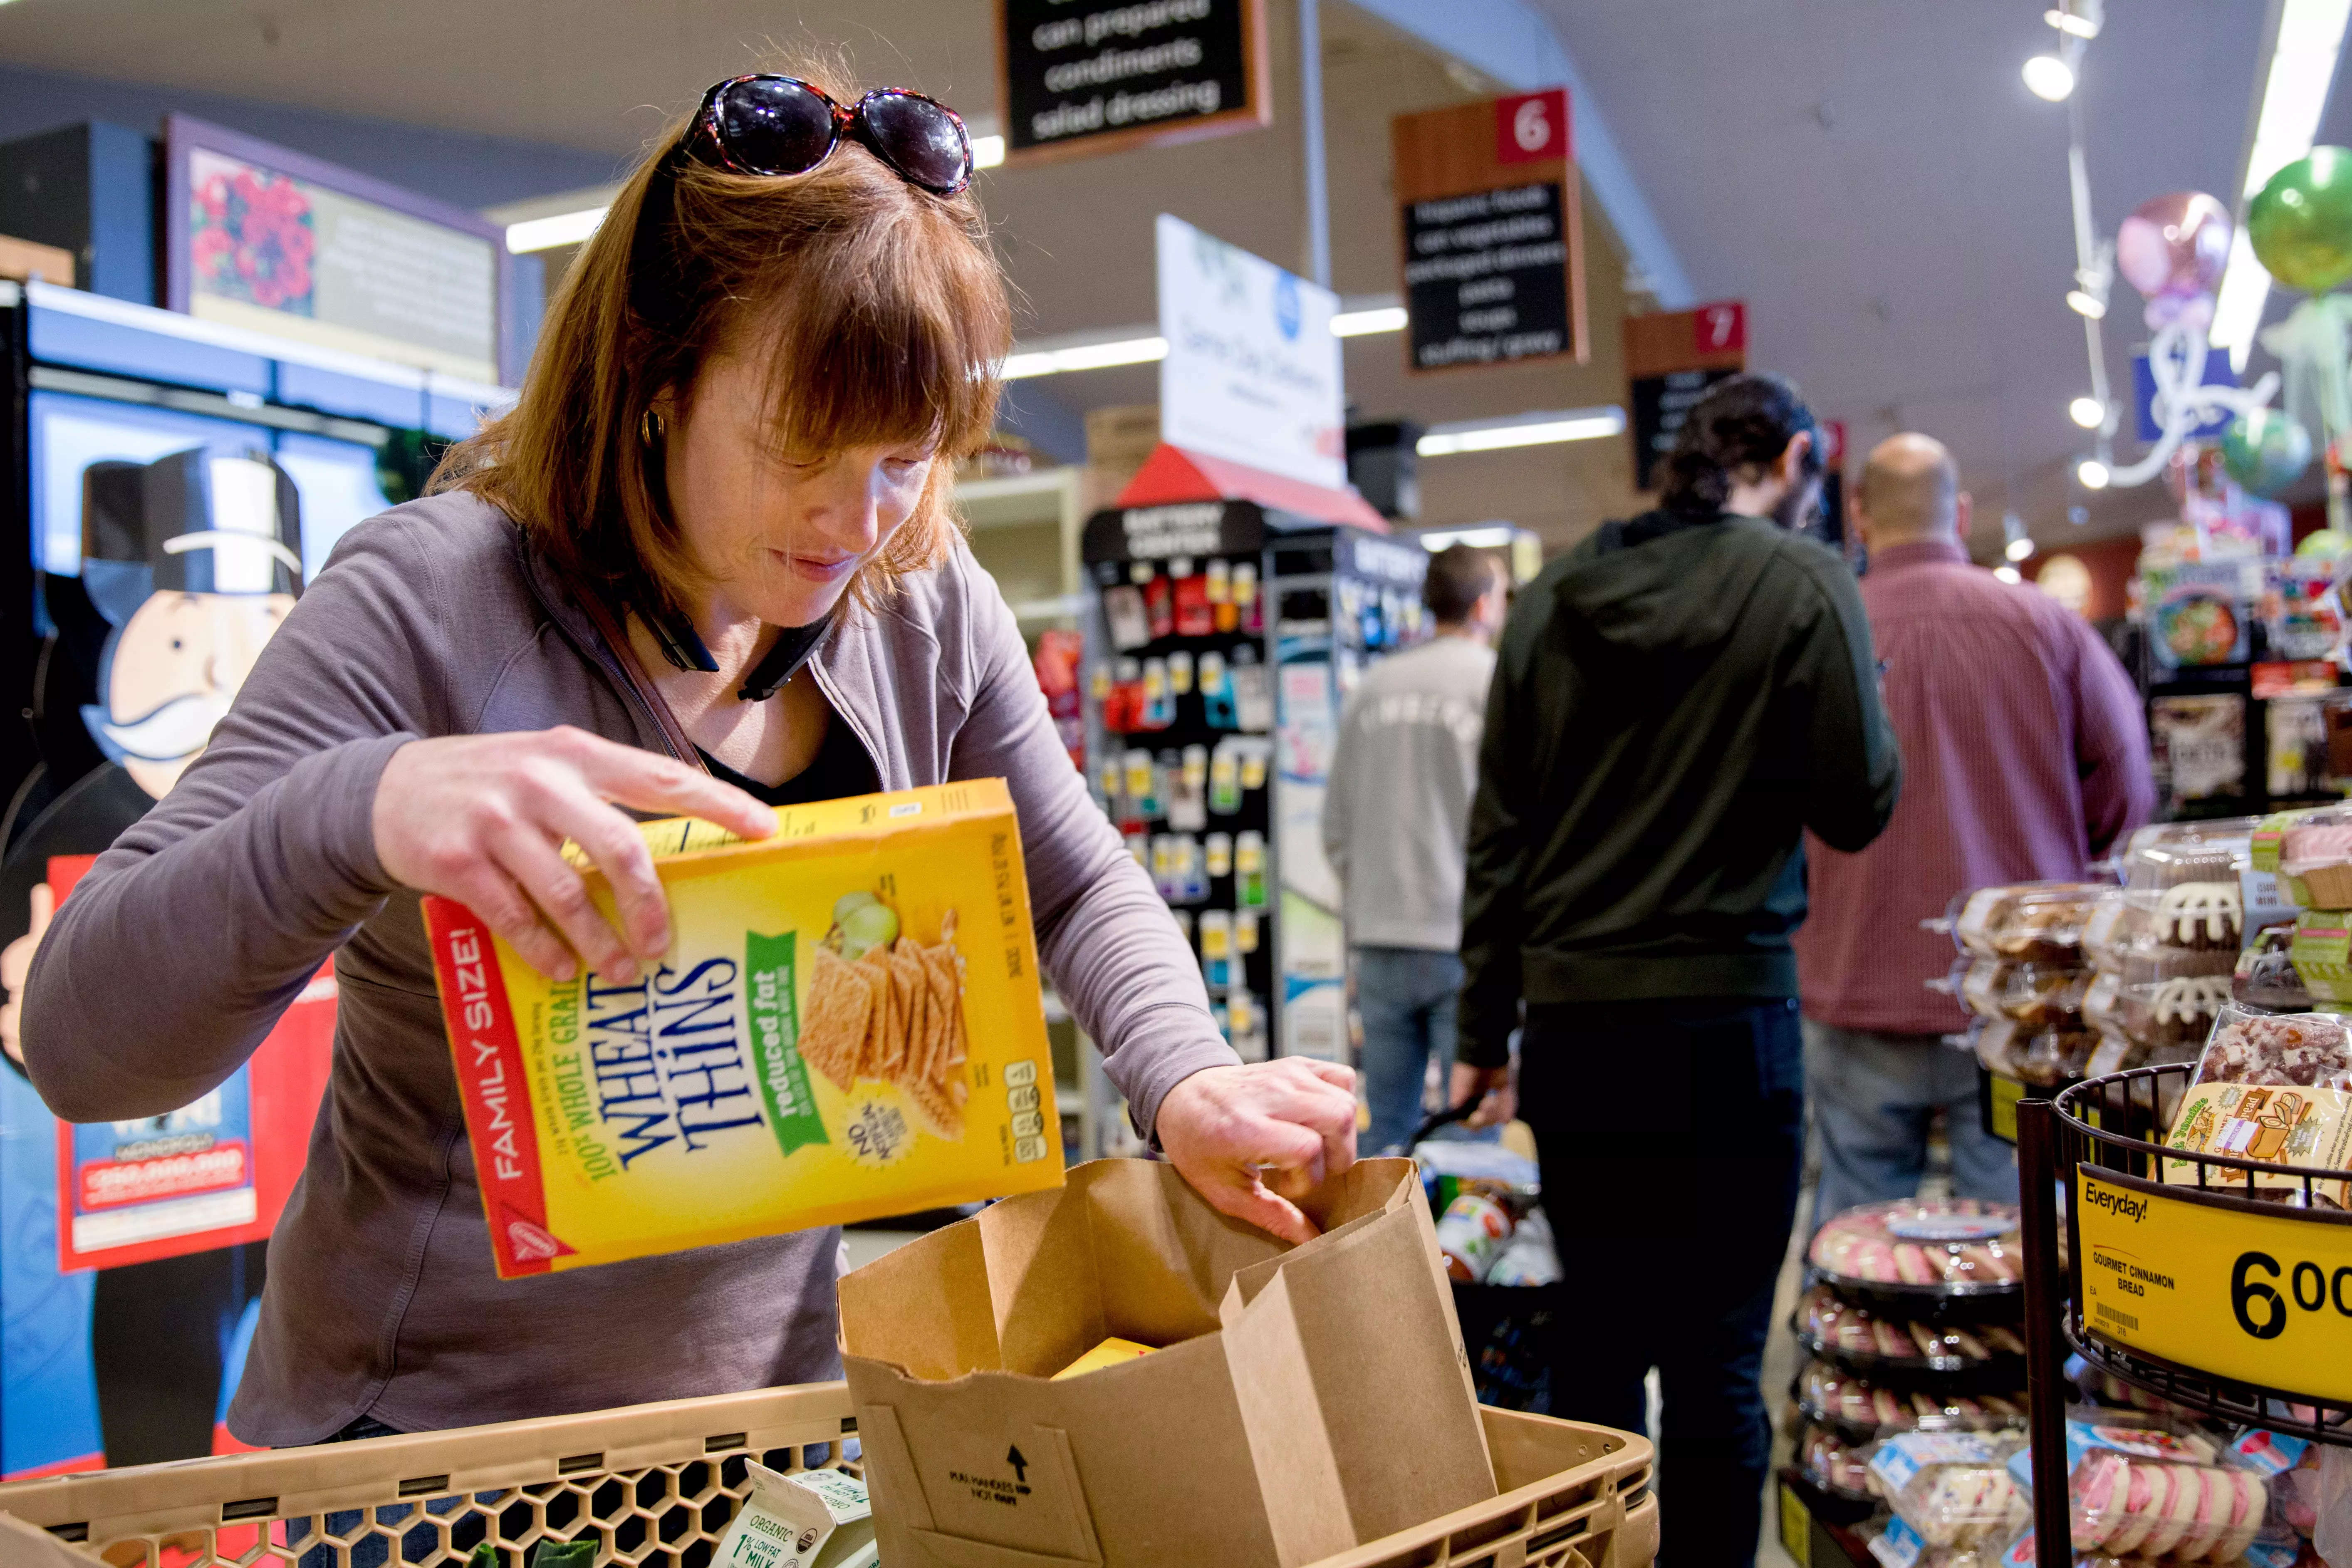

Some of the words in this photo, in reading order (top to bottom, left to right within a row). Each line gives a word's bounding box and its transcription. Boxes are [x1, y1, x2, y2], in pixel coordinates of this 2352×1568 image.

[1033, 19, 1081, 51] can
[1085, 0, 1210, 46] prepared
[1045, 37, 1203, 92] condiments
[1032, 95, 1104, 139] salad
[1105, 79, 1221, 125] dressing
[1514, 99, 1550, 152] 6
[1707, 307, 1735, 347] 7
[450, 926, 493, 1030] SIZE!
[753, 970, 778, 1011] fat
[587, 973, 676, 1170] WHEAT
[756, 1014, 797, 1117] reduced
[473, 1040, 522, 1180] FAMILY
[552, 1051, 595, 1129] WHOLE
[579, 1126, 617, 1181] 100%
[2228, 1125, 2241, 1142] BAKERY
[2085, 1182, 2147, 1222] Everyday!
[2090, 1285, 2097, 1296] EA
[2093, 1251, 2127, 1274] GOURMET
[2129, 1265, 2174, 1290] CINNAMON
[2118, 1278, 2144, 1297] BREAD
[831, 1482, 864, 1494] MILK
[733, 1534, 755, 1558] 1%
[750, 1515, 793, 1542] ORGANIC
[745, 1551, 775, 1568] MILK
